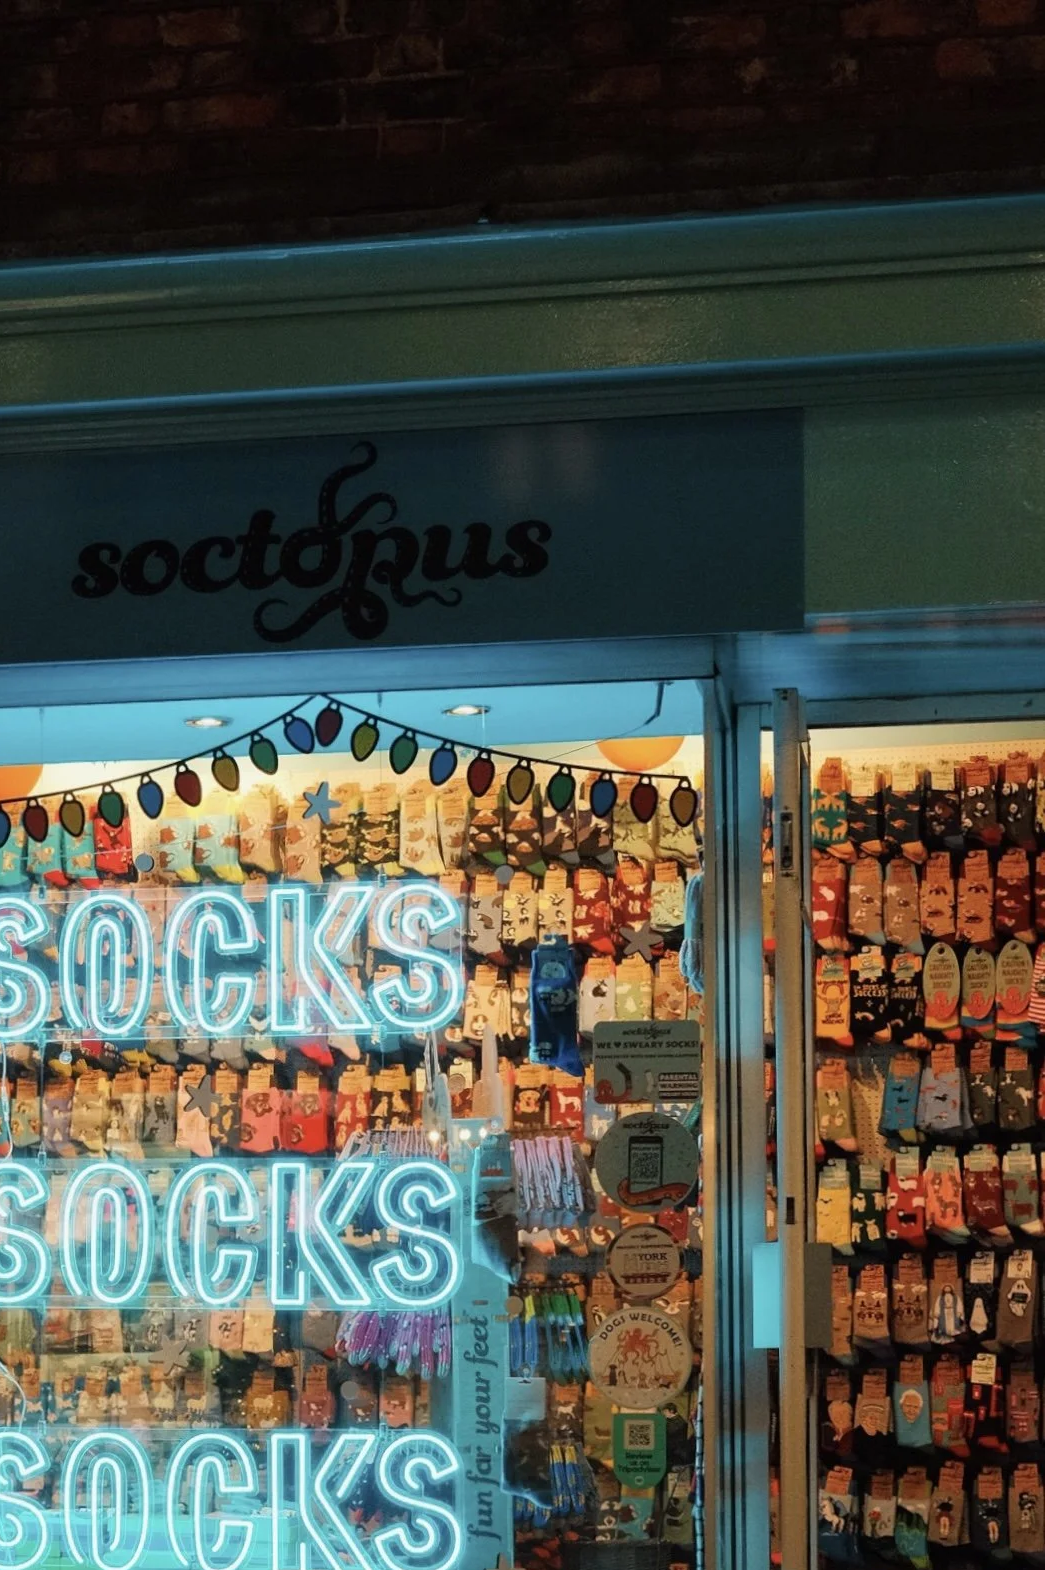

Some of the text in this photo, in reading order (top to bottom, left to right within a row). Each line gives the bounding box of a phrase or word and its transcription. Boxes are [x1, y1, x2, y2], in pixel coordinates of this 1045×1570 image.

[596, 1040, 699, 1049] WE SWEARY SOCKS!
[638, 1253, 667, 1261] YORK
[599, 1312, 683, 1347] DOGS WELCOME!
[475, 1372, 501, 1435] your
